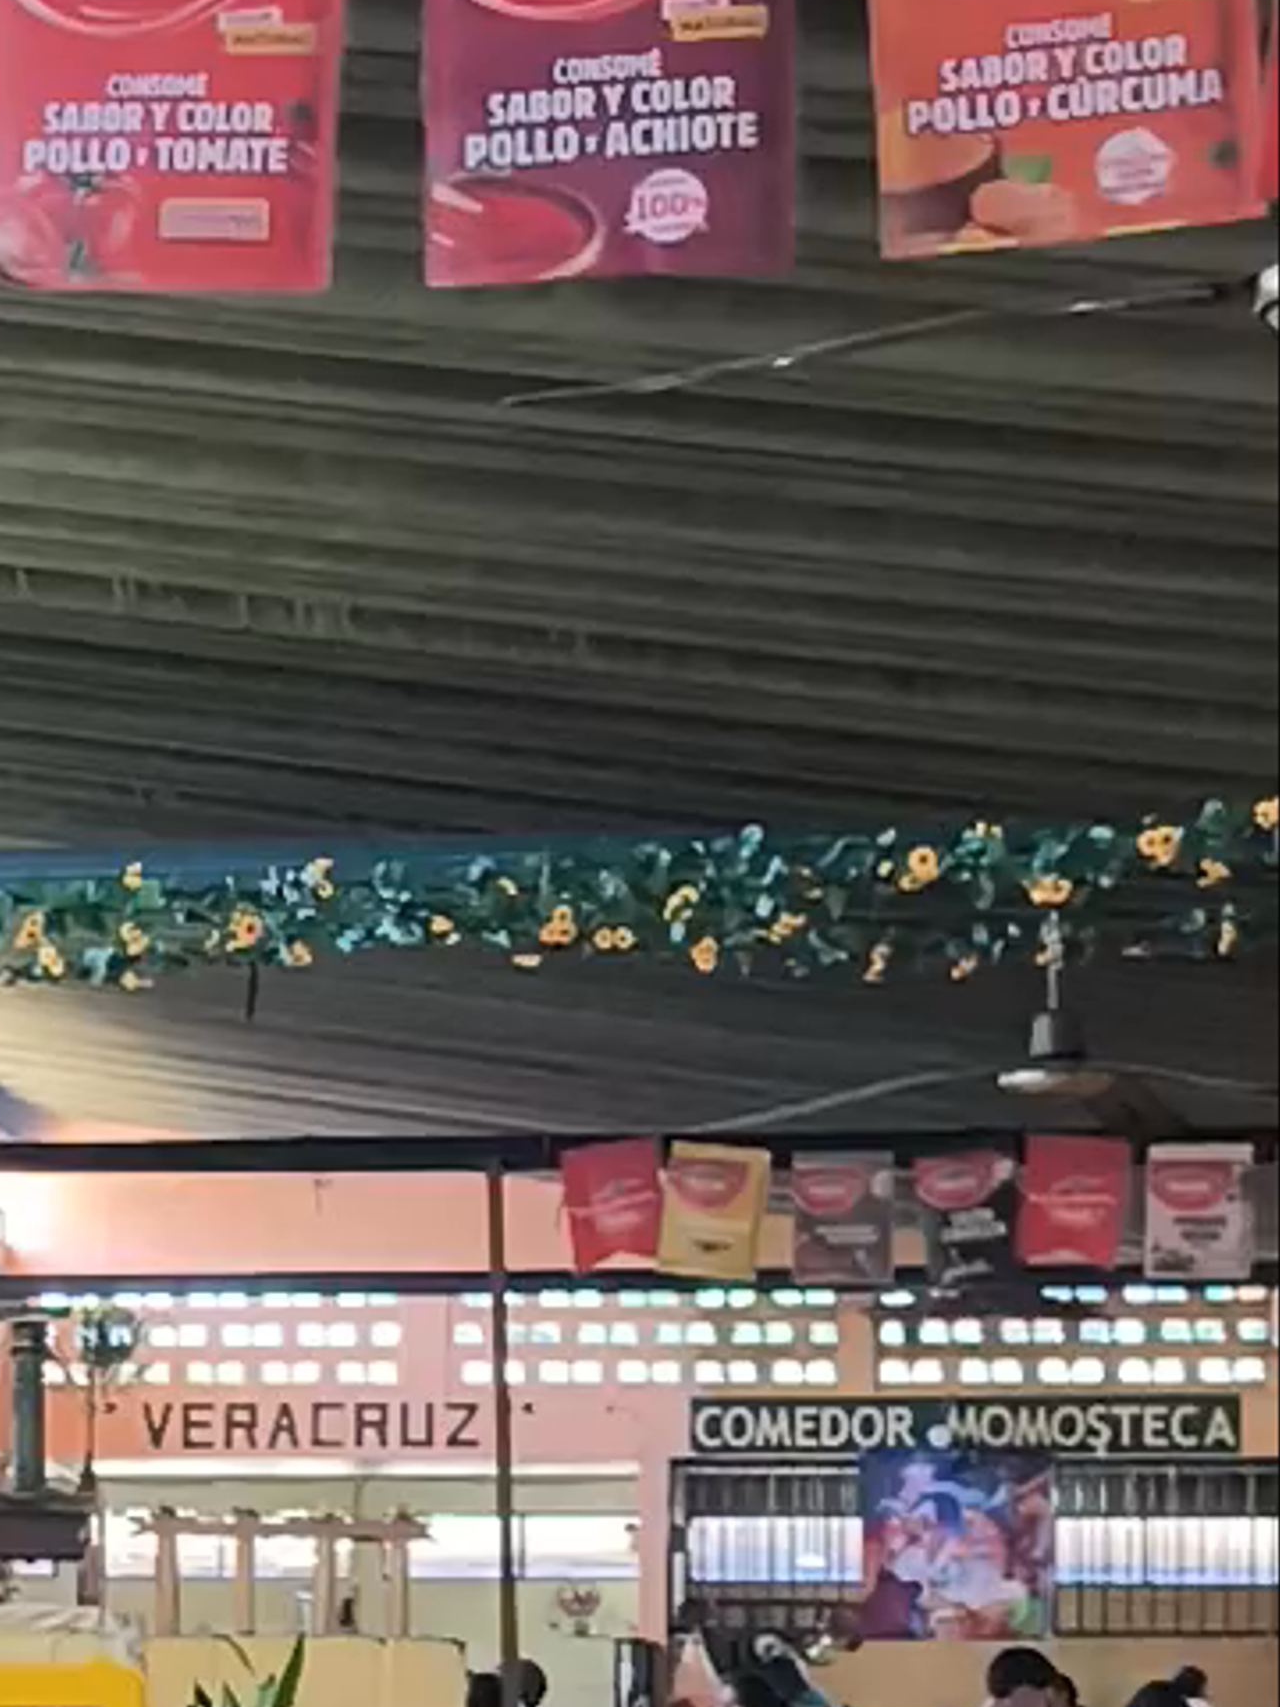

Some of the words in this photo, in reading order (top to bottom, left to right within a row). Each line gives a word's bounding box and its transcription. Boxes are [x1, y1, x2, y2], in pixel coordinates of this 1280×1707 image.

[940, 56, 1048, 92] SABOR
[1055, 49, 1075, 77] Y
[1084, 35, 1186, 76] COLOR
[44, 102, 142, 133] SABOR
[151, 103, 167, 132] Y
[177, 102, 273, 133] COLOR
[488, 92, 595, 126] SABOR
[605, 90, 622, 115] Y
[631, 77, 735, 113] COLOR
[908, 97, 1020, 135] POLLO
[24, 139, 131, 174] POLLO
[156, 138, 288, 173] TOMATE
[464, 126, 579, 168] POLLO
[606, 112, 759, 156] ACHIOTE
[143, 1403, 480, 1449] VERACRUZ
[694, 1405, 914, 1448] COMEDOR
[949, 1403, 1237, 1450] MOMOSTECA
